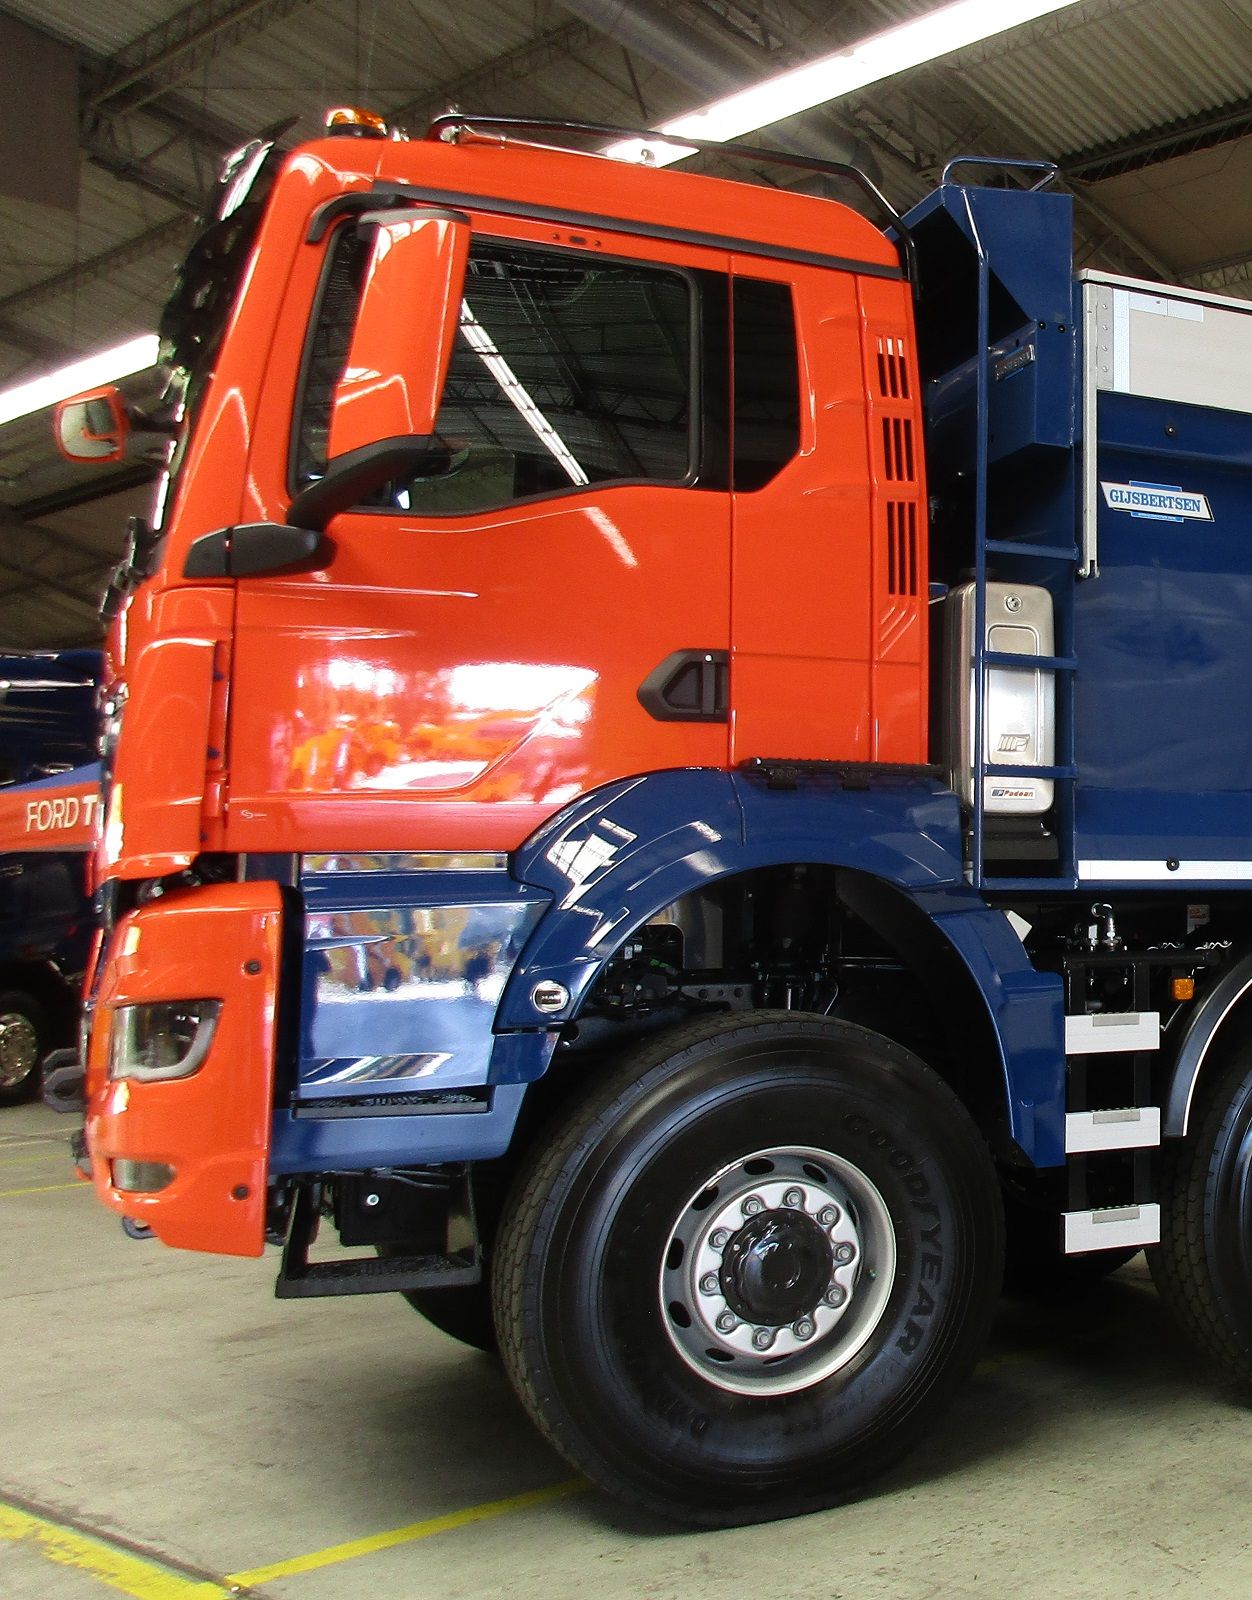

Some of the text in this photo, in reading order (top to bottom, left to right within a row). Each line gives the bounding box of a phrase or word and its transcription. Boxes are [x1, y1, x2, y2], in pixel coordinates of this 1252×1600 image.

[1109, 488, 1201, 512] GIJSBERTSEN
[26, 797, 80, 832] FORD
[842, 1112, 945, 1356] GOODYEAR
